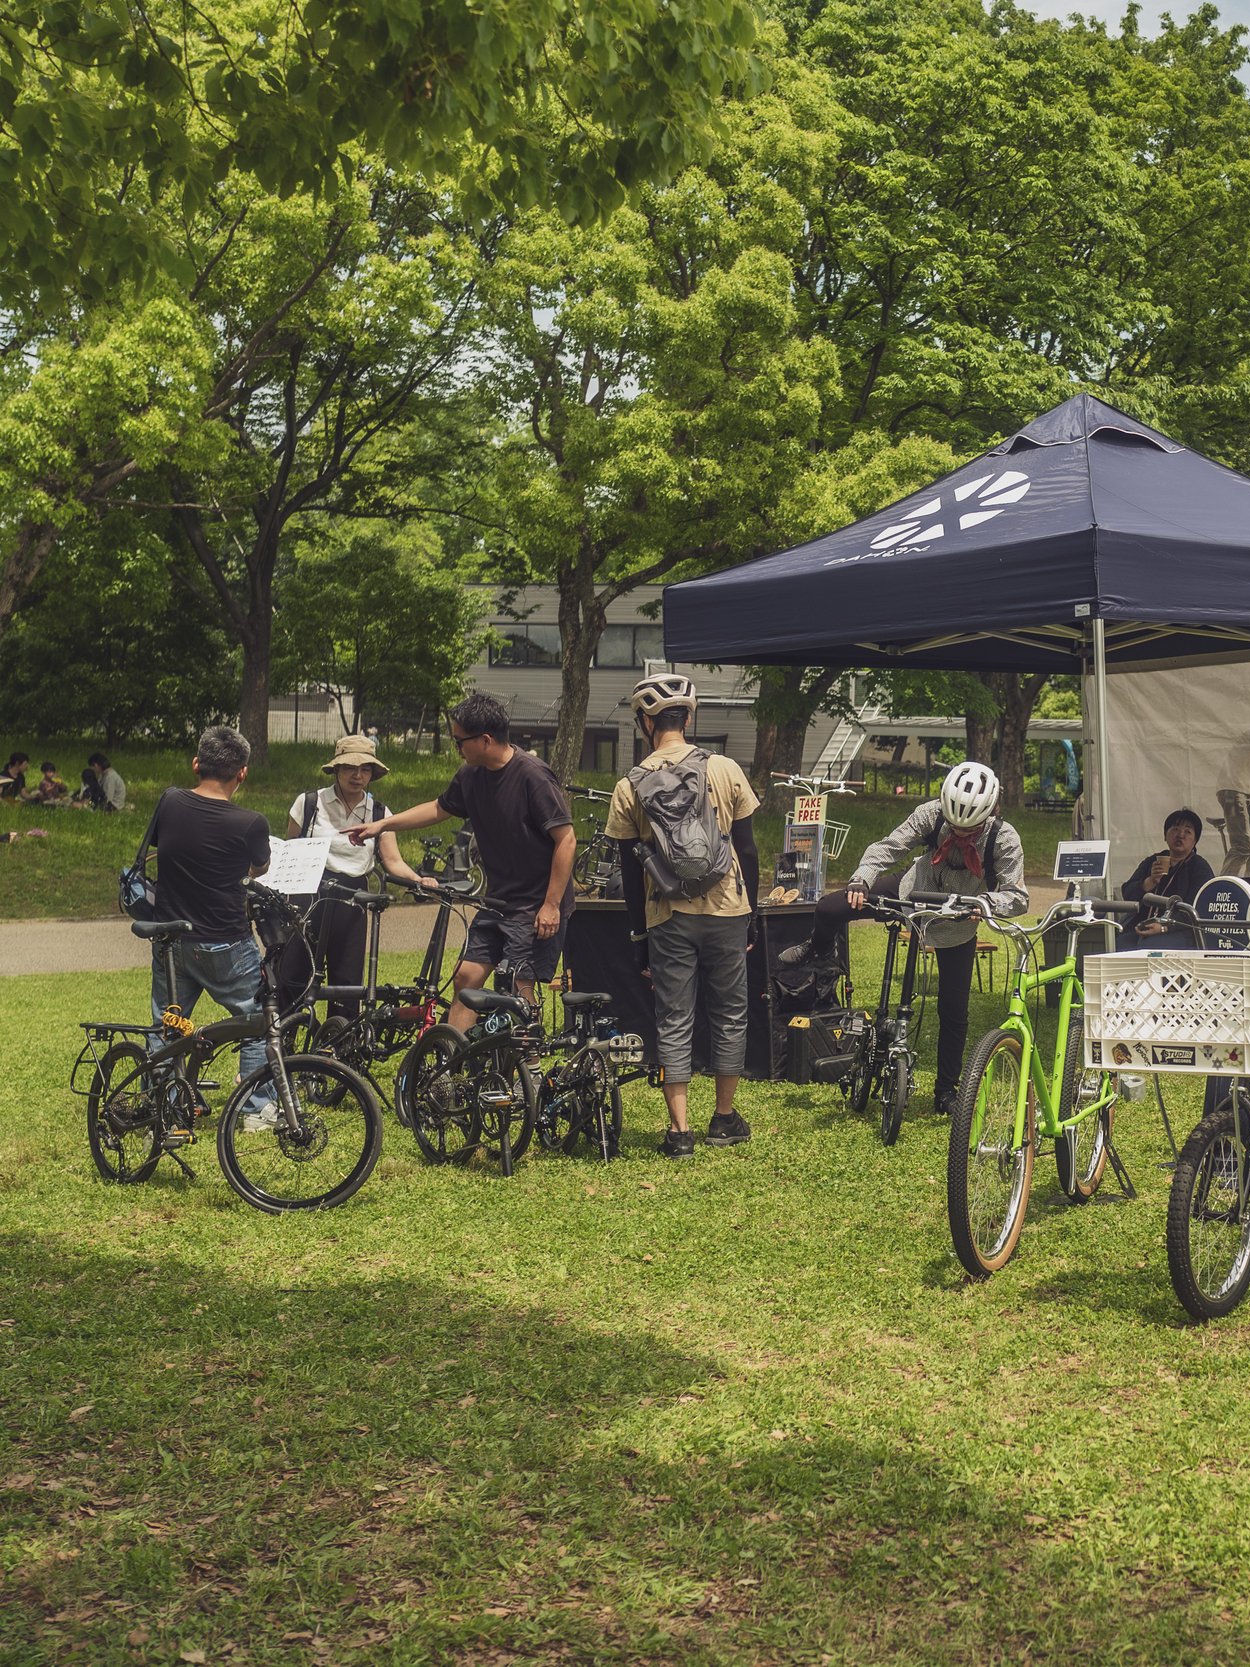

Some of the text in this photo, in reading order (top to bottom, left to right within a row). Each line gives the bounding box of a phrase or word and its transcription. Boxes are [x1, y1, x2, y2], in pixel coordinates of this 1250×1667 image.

[799, 797, 822, 808] TAKE
[798, 810, 820, 822] FREE
[1216, 892, 1231, 902] RIDE
[1208, 902, 1239, 913] BICYCLES,
